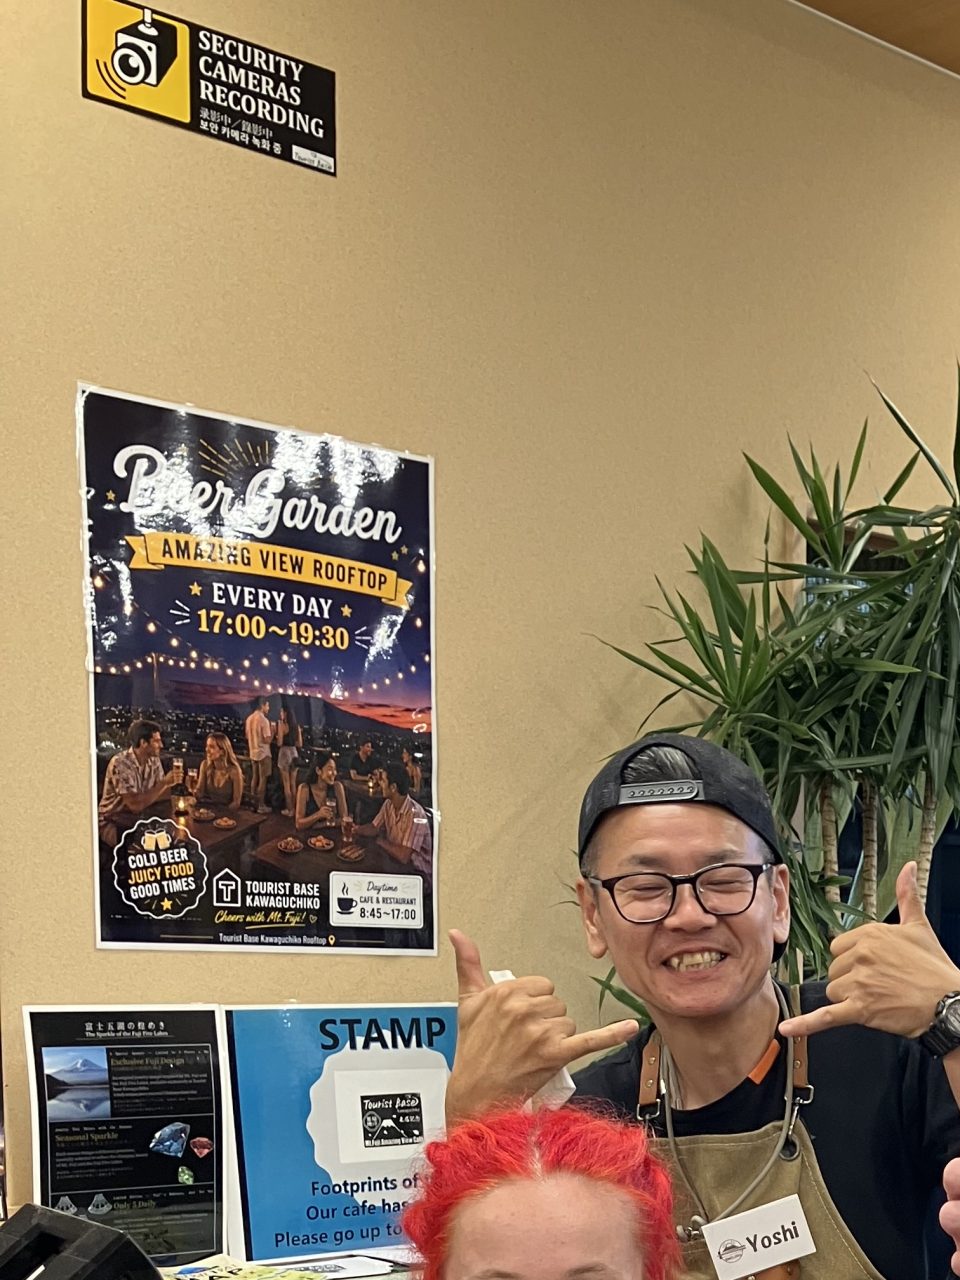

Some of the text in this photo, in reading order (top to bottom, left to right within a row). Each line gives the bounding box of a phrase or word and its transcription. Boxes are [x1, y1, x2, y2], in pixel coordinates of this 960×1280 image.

[198, 30, 304, 82] SECURITY
[198, 56, 301, 106] CAMERAS
[199, 80, 325, 139] RECORDING
[113, 444, 402, 543] Beer Garden
[162, 538, 388, 592] AMAZING VIEW ROOFTOP
[212, 582, 333, 619] EVERY DAY
[128, 847, 189, 869] COLD BEER
[128, 862, 194, 885] JUICY FOOD
[130, 877, 196, 899] GOOD TIMES
[245, 880, 320, 896] TOURIST BASE
[366, 880, 399, 895] Daytime
[246, 895, 320, 909] KAWAGUCHIKO
[381, 897, 417, 906] RESTAURANT
[214, 909, 245, 924] Cheers
[245, 911, 265, 922] with
[267, 911, 282, 922] Mt.
[219, 933, 242, 942] Tourist
[244, 934, 259, 943] Base
[319, 1016, 446, 1051] STAMP
[363, 1098, 393, 1110] Tourist
[311, 1173, 419, 1197] Footprints of
[306, 1205, 338, 1221] Our
[343, 1200, 376, 1217] cafe
[275, 1223, 403, 1248] Please go up to
[746, 1220, 800, 1253] Yoshi
